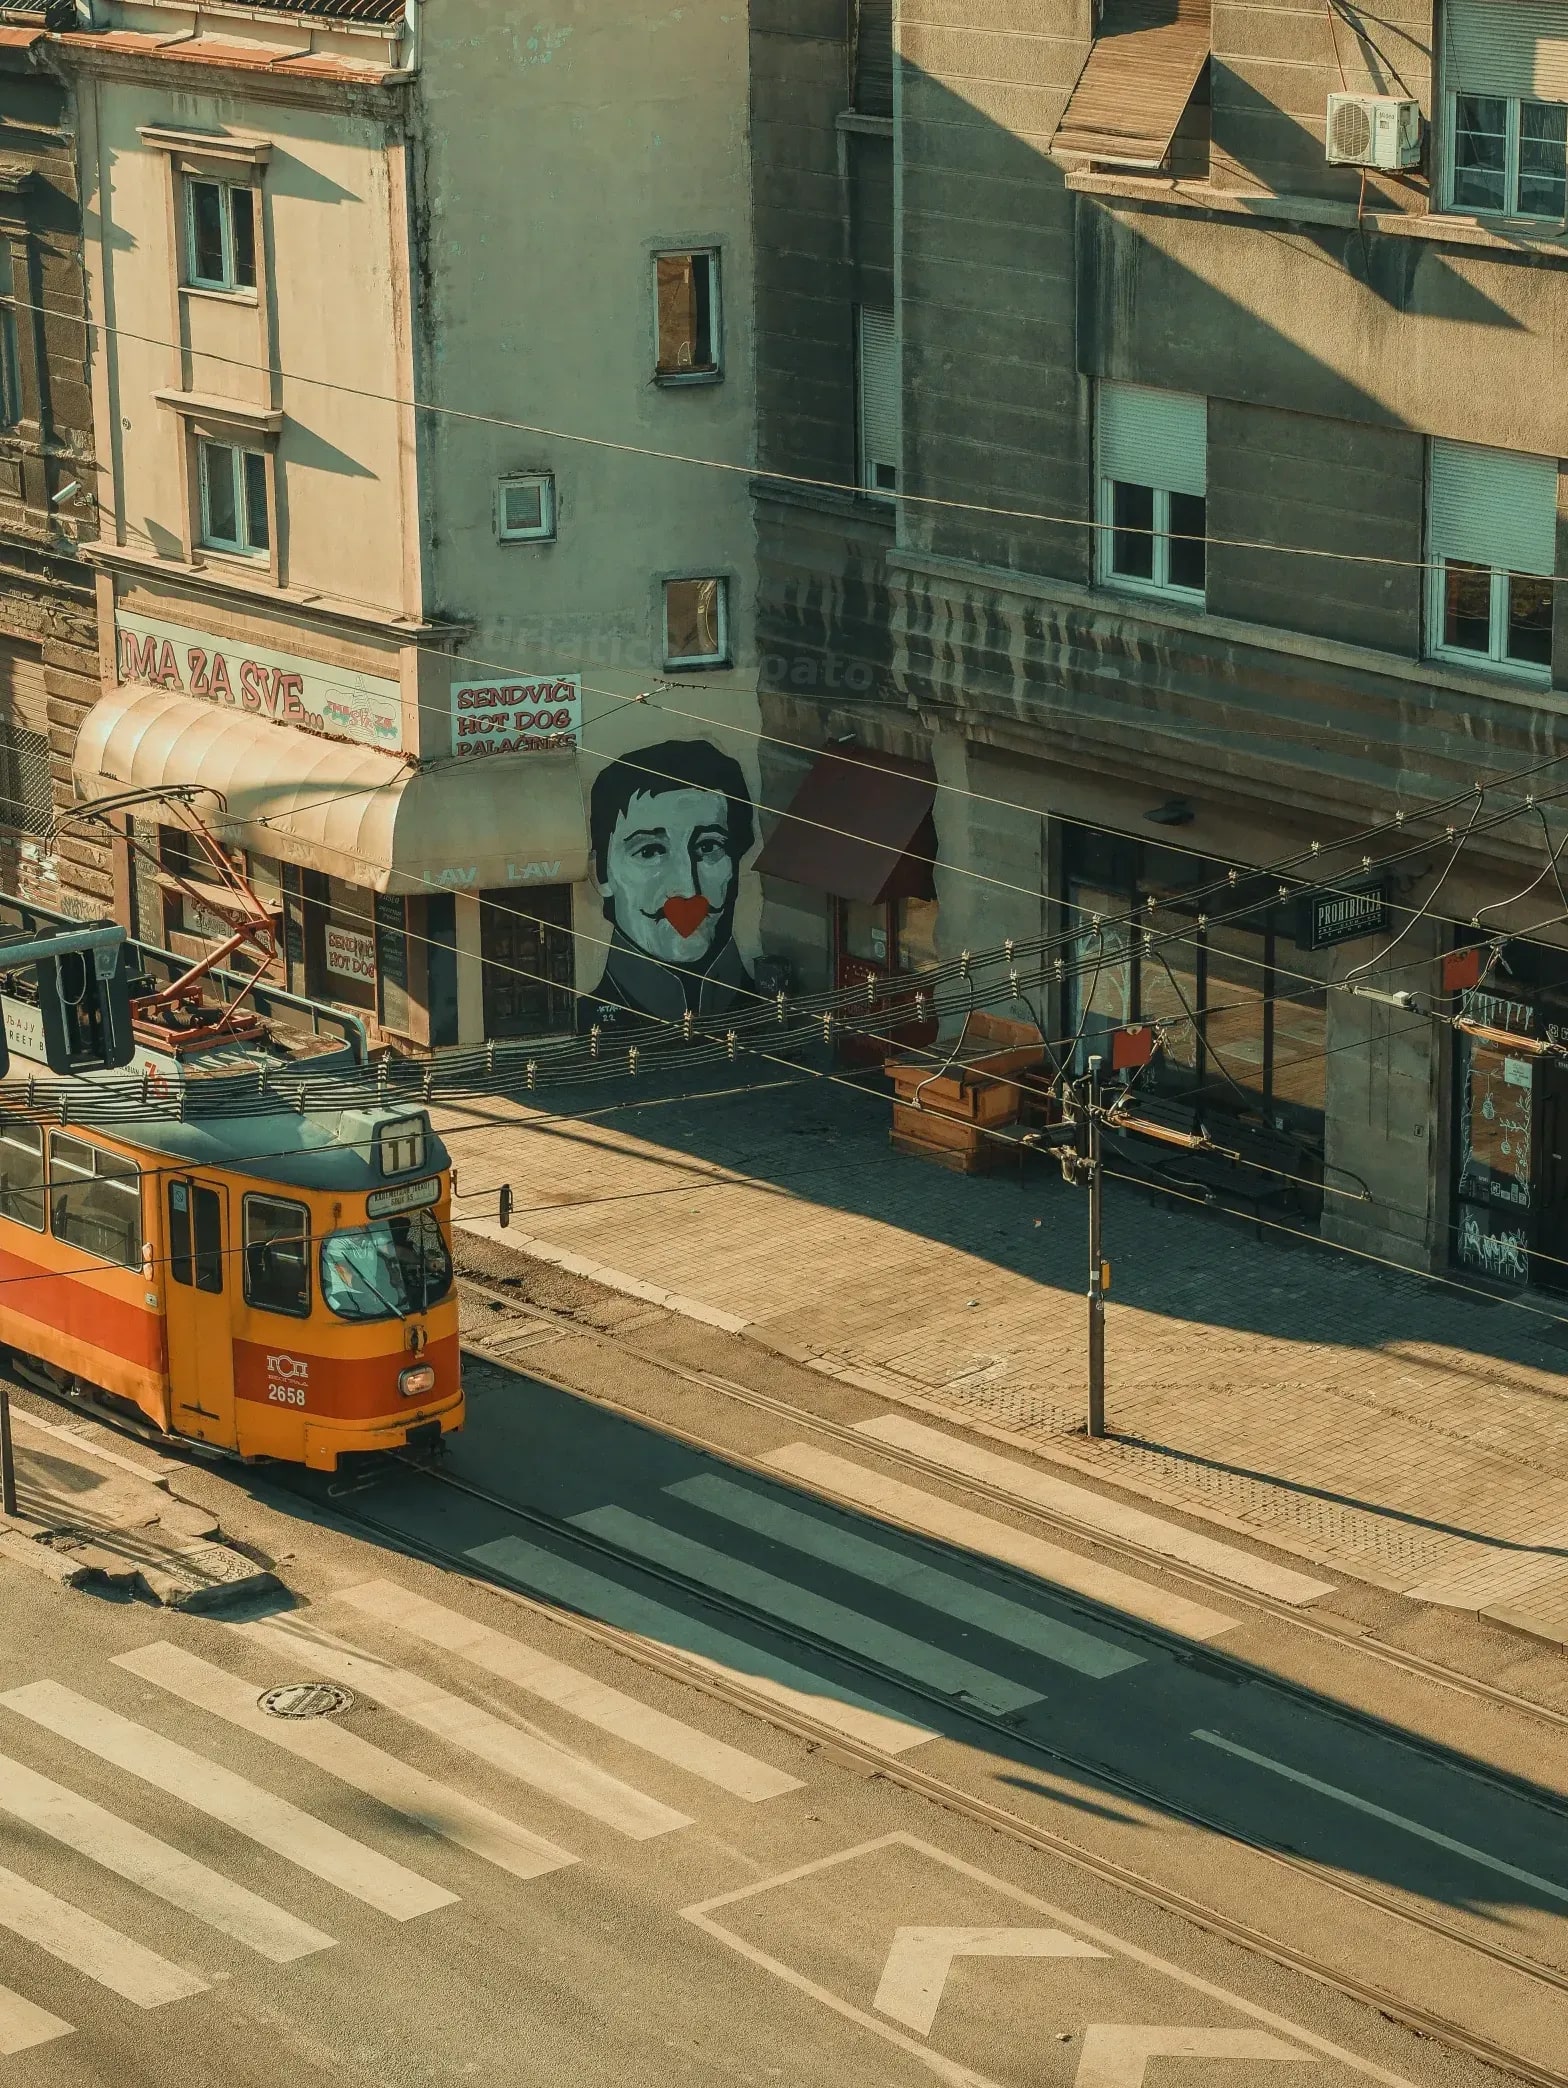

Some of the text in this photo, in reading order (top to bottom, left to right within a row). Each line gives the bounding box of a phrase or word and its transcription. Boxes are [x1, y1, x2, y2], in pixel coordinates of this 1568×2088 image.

[118, 629, 184, 691] IMA
[187, 648, 235, 704] ZA
[457, 677, 577, 710] SENDVIČI
[457, 708, 572, 736] HOT DOG
[423, 860, 560, 886] LAV LAV
[1318, 891, 1381, 927] PROHIBICIJA
[328, 951, 350, 971] HOT
[387, 1131, 417, 1171] 11
[268, 1383, 305, 1406] 2658
